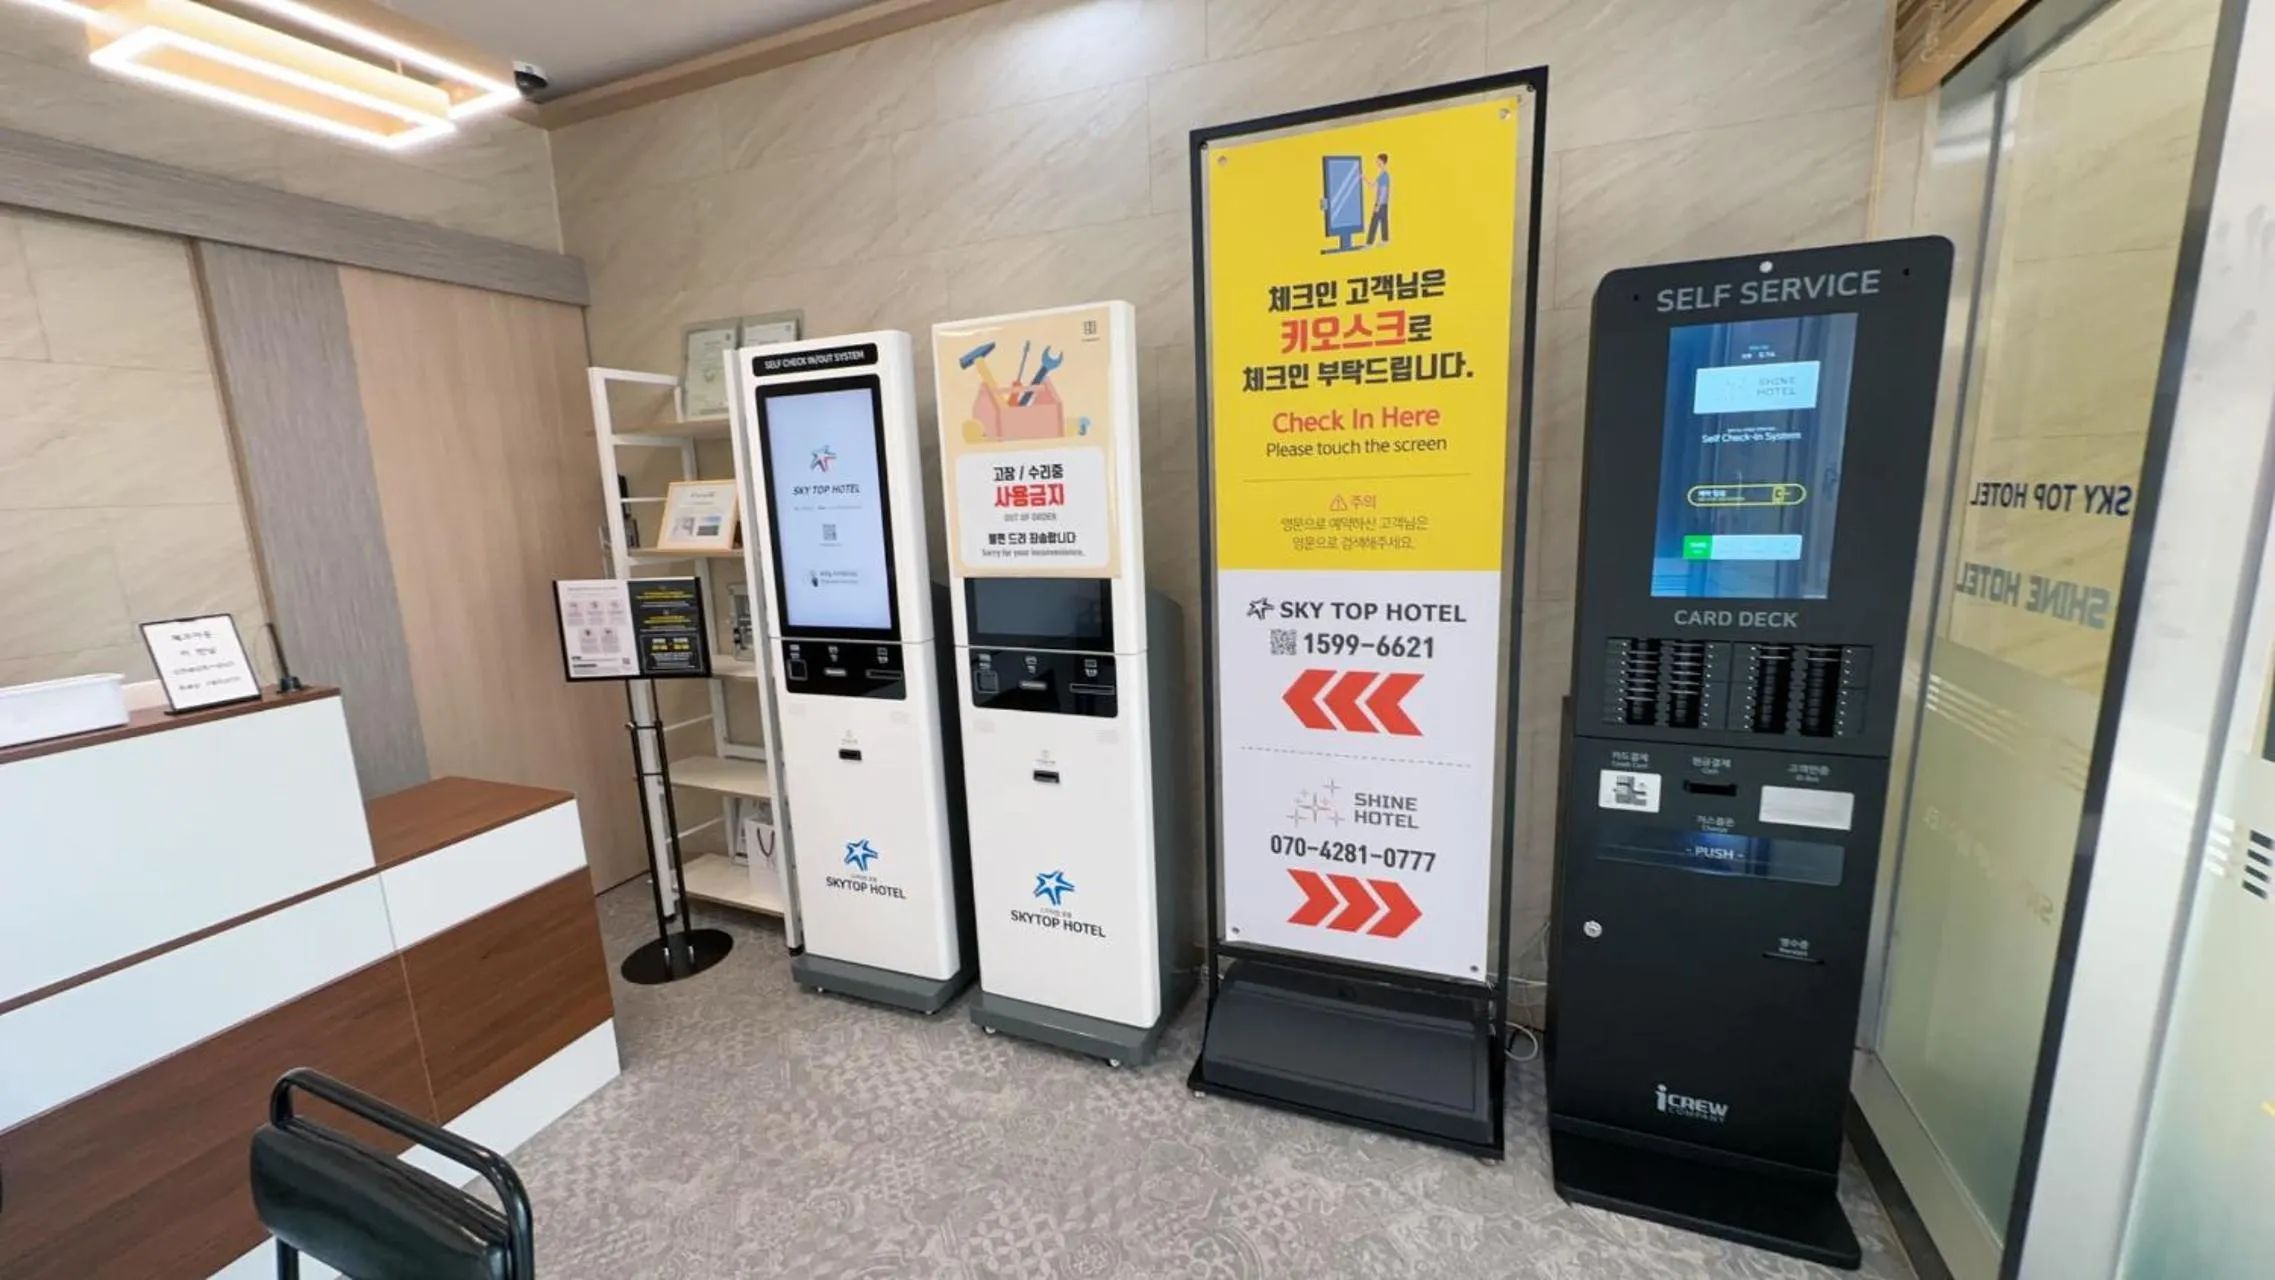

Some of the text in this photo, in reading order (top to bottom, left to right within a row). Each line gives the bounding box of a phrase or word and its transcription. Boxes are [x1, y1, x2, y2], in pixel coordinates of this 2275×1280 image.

[1268, 269, 1446, 312] 체크인 고객님은
[1656, 269, 1881, 313] SELF SERVICE
[1280, 311, 1432, 354] 키오스크로
[764, 359, 782, 370] SELF
[783, 356, 807, 368] CHECK
[834, 350, 865, 362] SYSTEM
[1242, 352, 1474, 392] 체크인 부탁드립니다.
[1273, 406, 1441, 434] Check In Here
[1266, 438, 1447, 457] Please touch the screen
[993, 465, 1015, 481] 고장
[1028, 463, 1064, 480] 수리중
[812, 484, 830, 495] TOP
[994, 483, 1065, 507] 사용금지
[1350, 494, 1377, 510] 주의
[1380, 516, 1429, 531] 고객님은
[1280, 601, 1467, 623] SKY TOP HOTEL
[1674, 610, 1799, 628] CARD DECK
[1303, 633, 1434, 658] 1599-6621
[1354, 792, 1418, 811] SHINE
[1354, 810, 1419, 829] HOTEL
[1270, 834, 1437, 873] 070-4281-0777
[1695, 846, 1734, 860] PUSH
[825, 875, 868, 893] SKYTOP
[870, 884, 907, 900] HOTEL
[1010, 909, 1060, 928] SKYTOP
[1063, 920, 1106, 938] HOTEL
